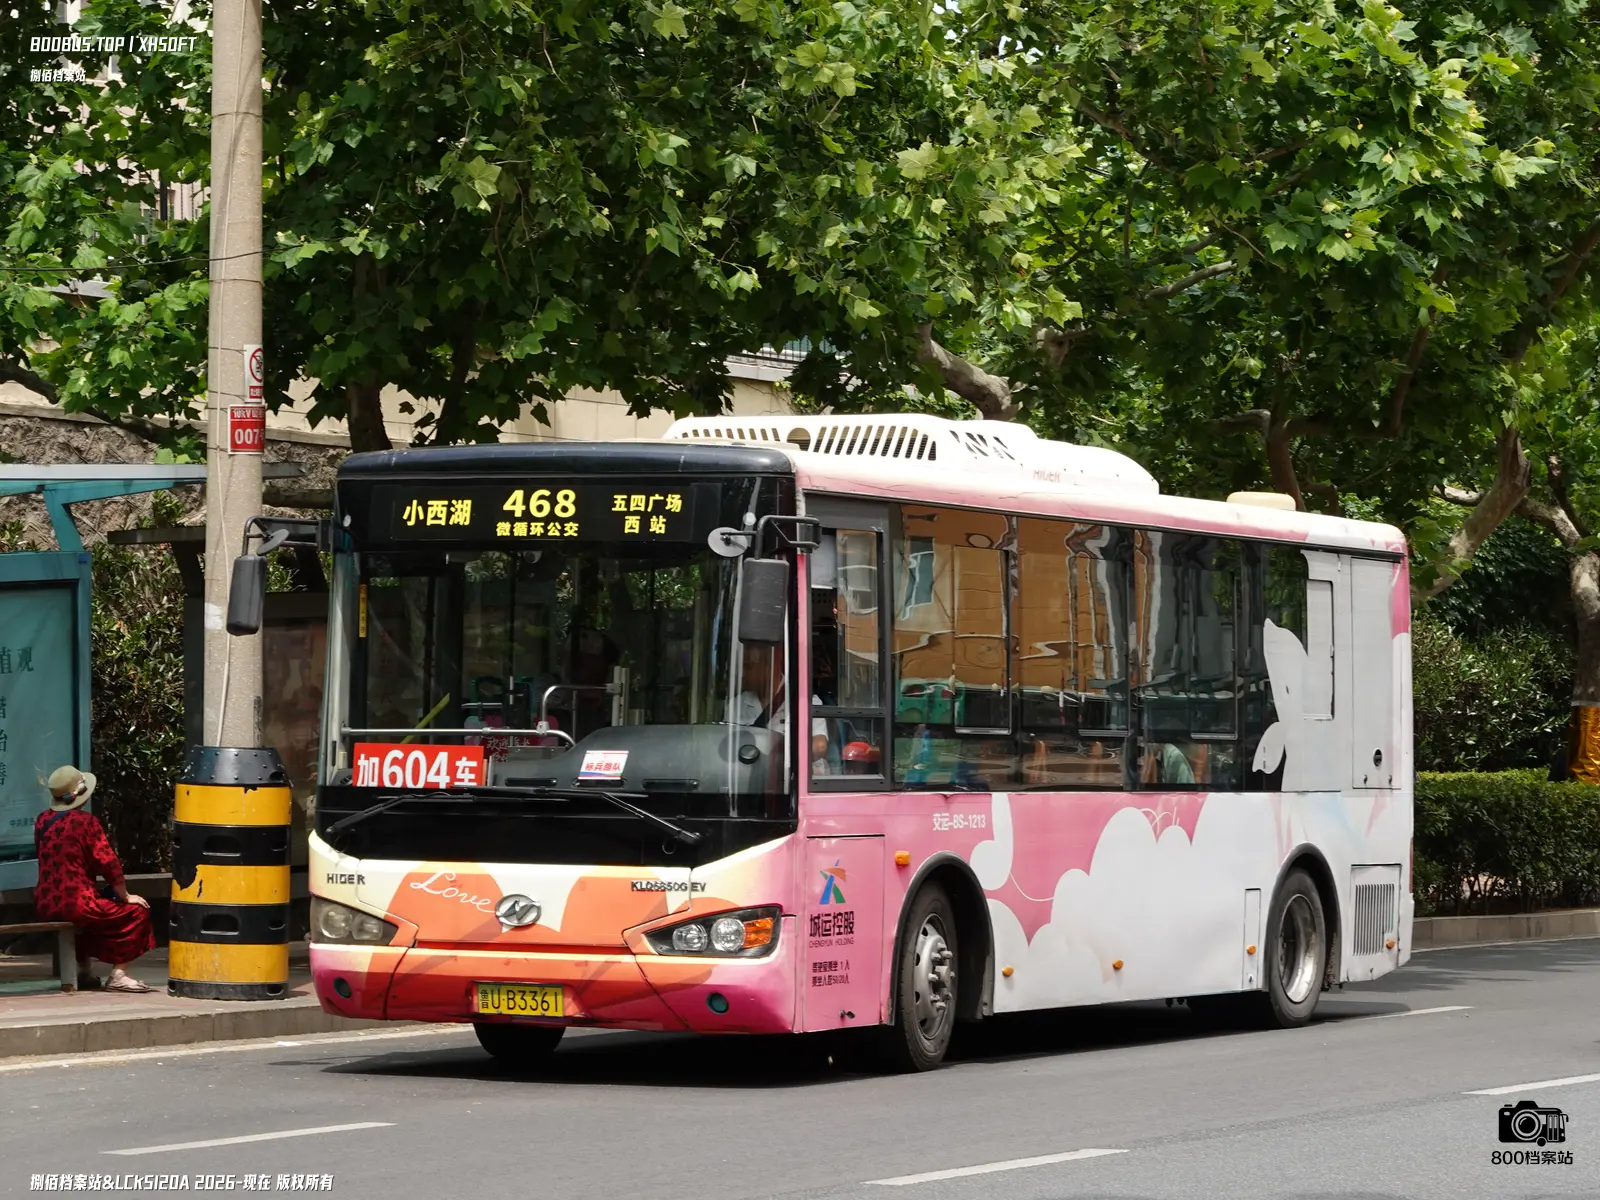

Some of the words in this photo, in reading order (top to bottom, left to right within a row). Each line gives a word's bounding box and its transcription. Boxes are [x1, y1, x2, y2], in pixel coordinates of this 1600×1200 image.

[234, 428, 259, 445] 007
[402, 499, 472, 526] 小西湖
[502, 489, 577, 518] 468
[611, 494, 683, 513] 五四广场
[496, 521, 579, 537] 微循环公交
[932, 812, 987, 831] 交运-BS-1213
[326, 873, 366, 885] HIGER
[409, 869, 496, 913] Love
[809, 911, 855, 937] 城运控股
